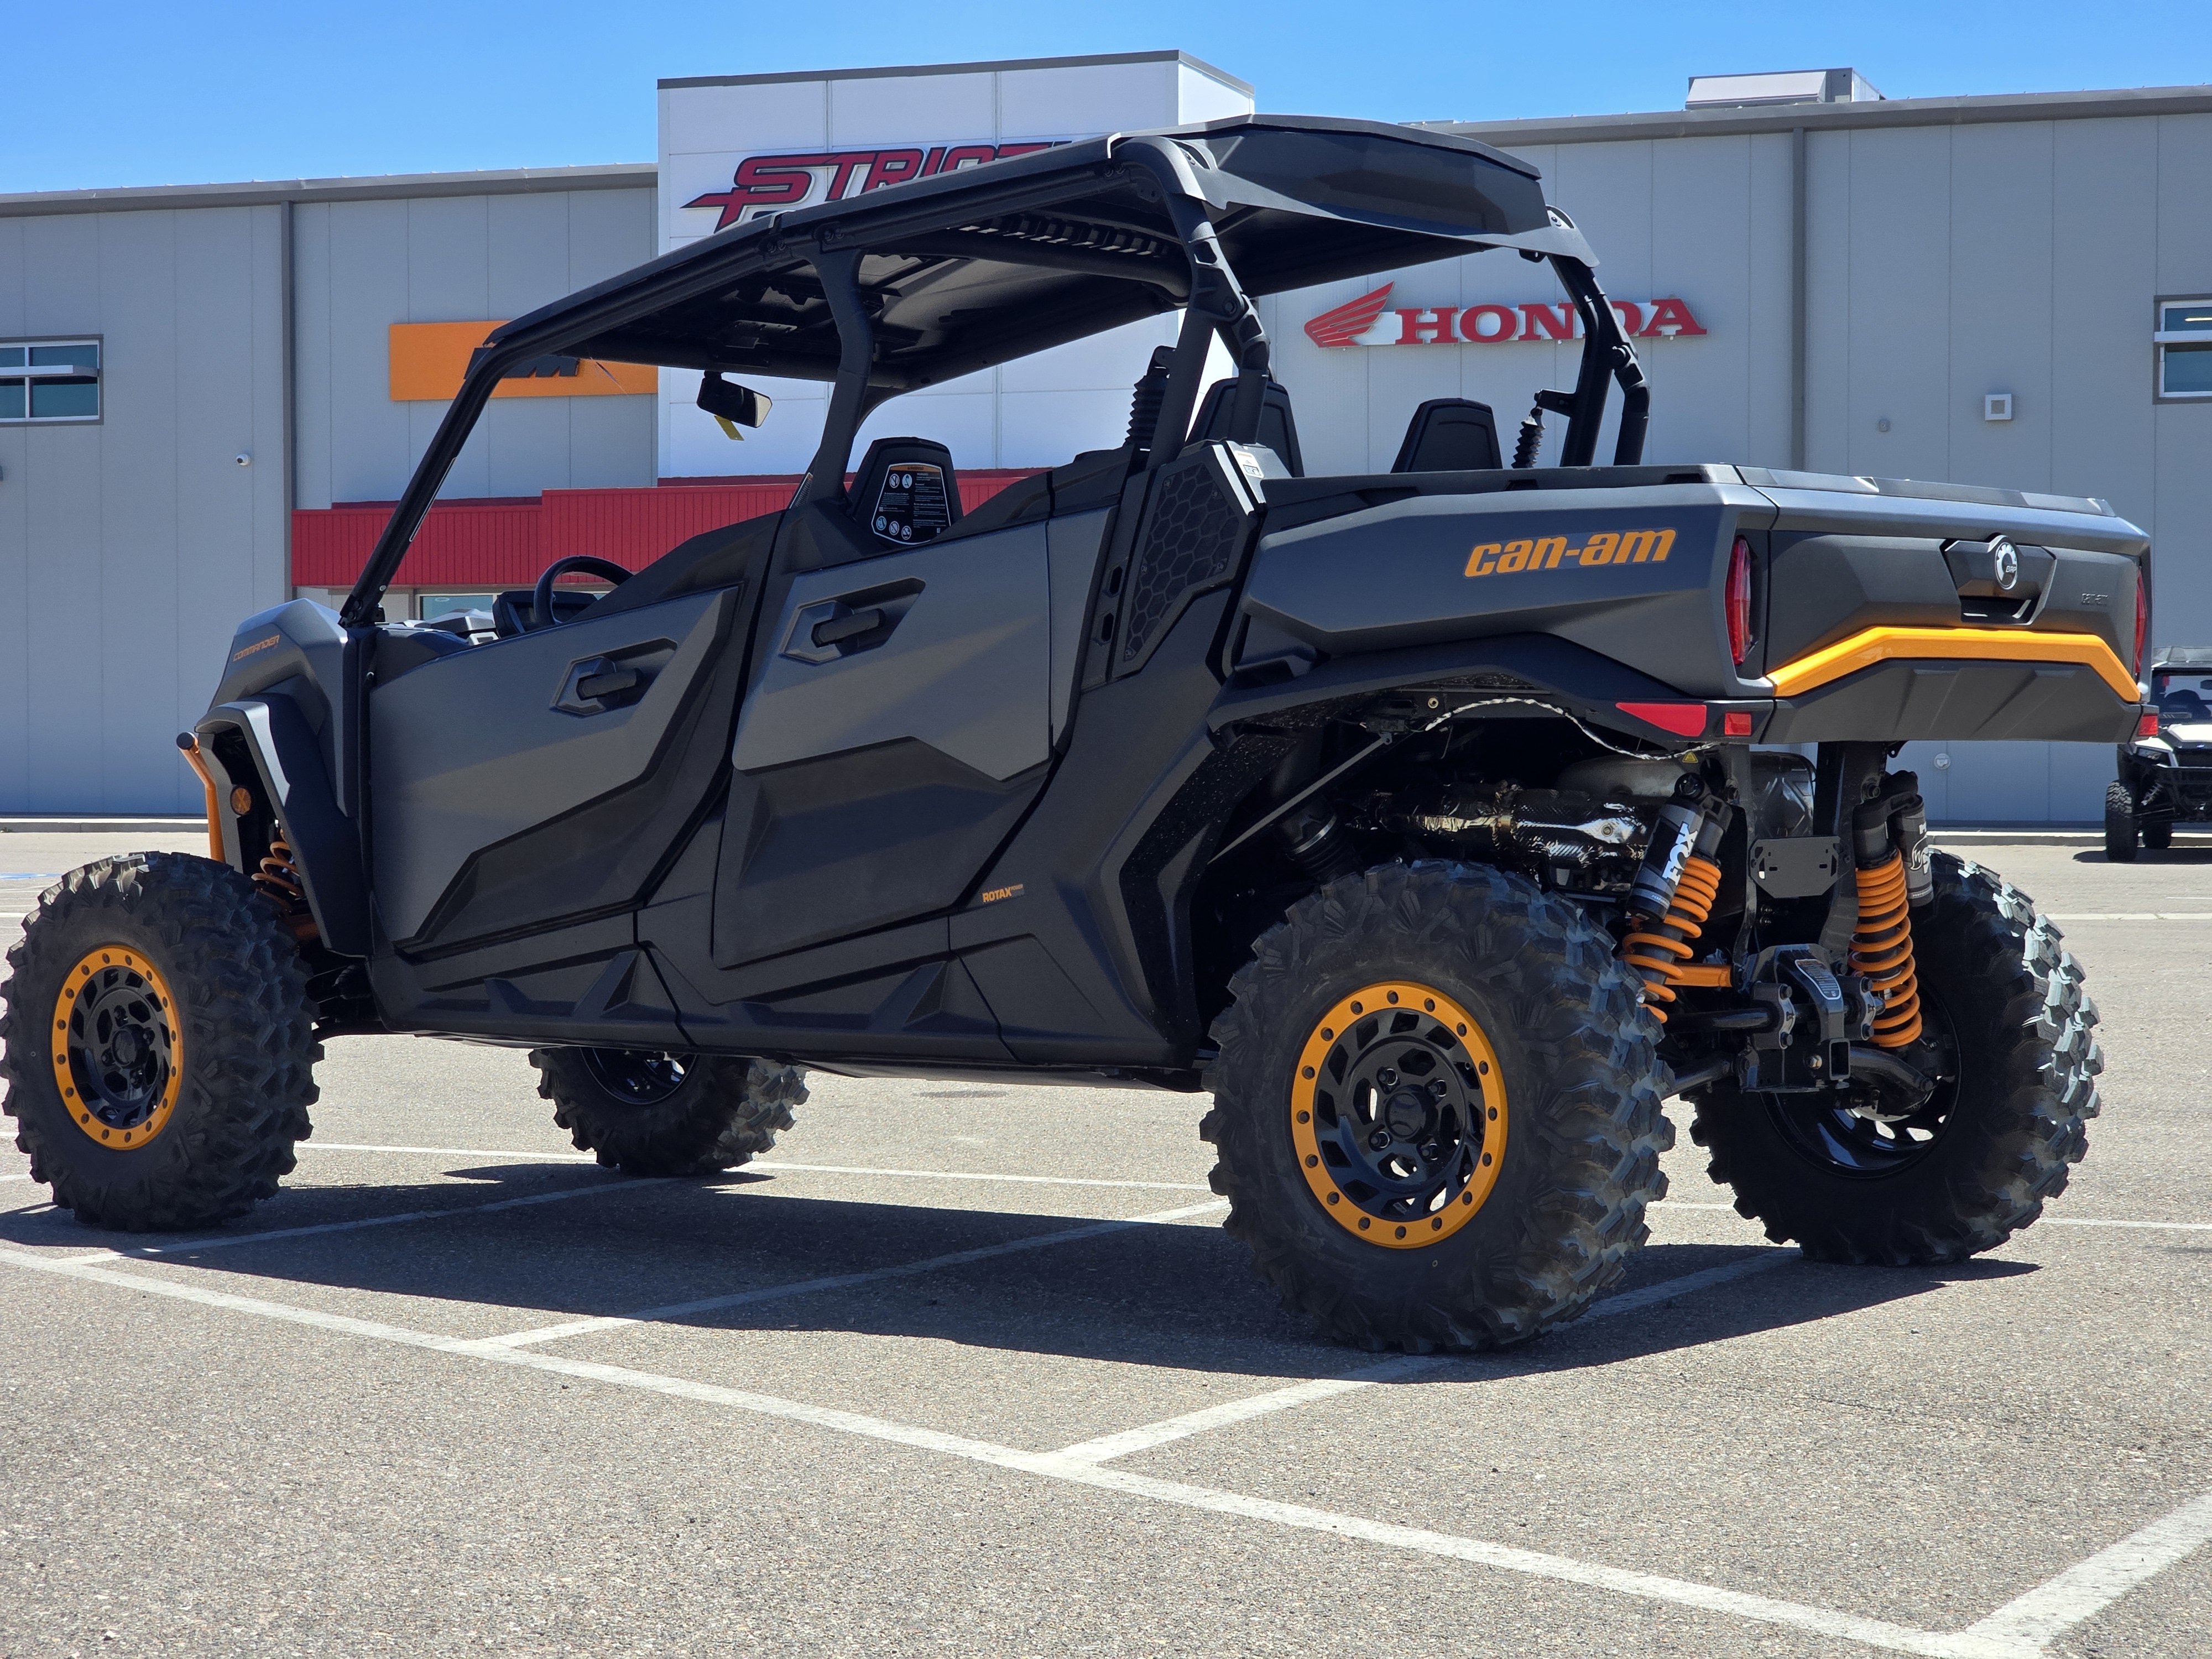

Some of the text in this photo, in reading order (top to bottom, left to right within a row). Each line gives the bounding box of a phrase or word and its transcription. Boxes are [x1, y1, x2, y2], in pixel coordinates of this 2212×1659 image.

[1463, 529, 1677, 578] can-am
[233, 634, 280, 662] COMMANDER
[1662, 821, 1698, 886] FOX
[982, 886, 1012, 903] ROTAX
